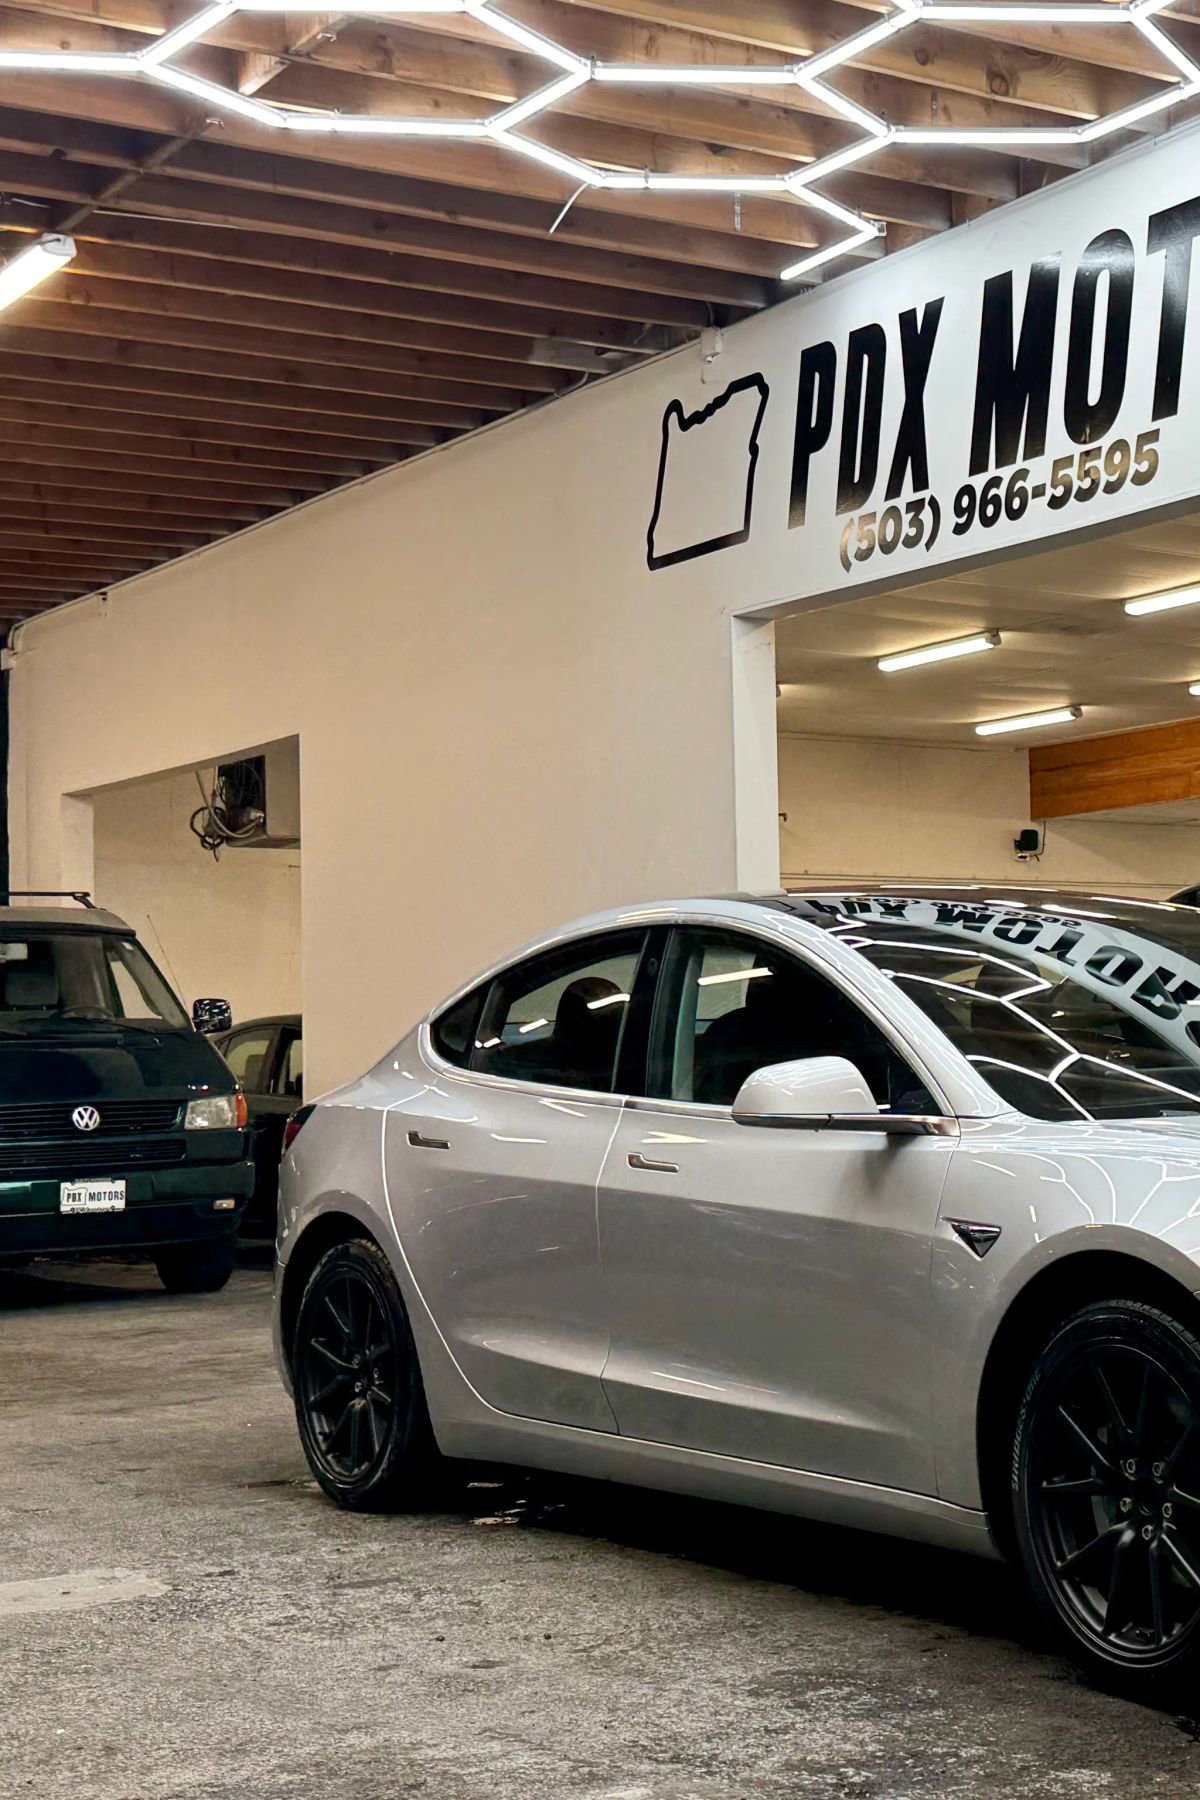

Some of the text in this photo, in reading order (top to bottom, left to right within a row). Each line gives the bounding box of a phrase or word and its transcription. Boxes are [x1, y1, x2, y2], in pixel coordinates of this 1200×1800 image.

[788, 297, 945, 529] PDX
[839, 430, 1160, 572] (503) 966-5595
[88, 1190, 125, 1202] MOTORS
